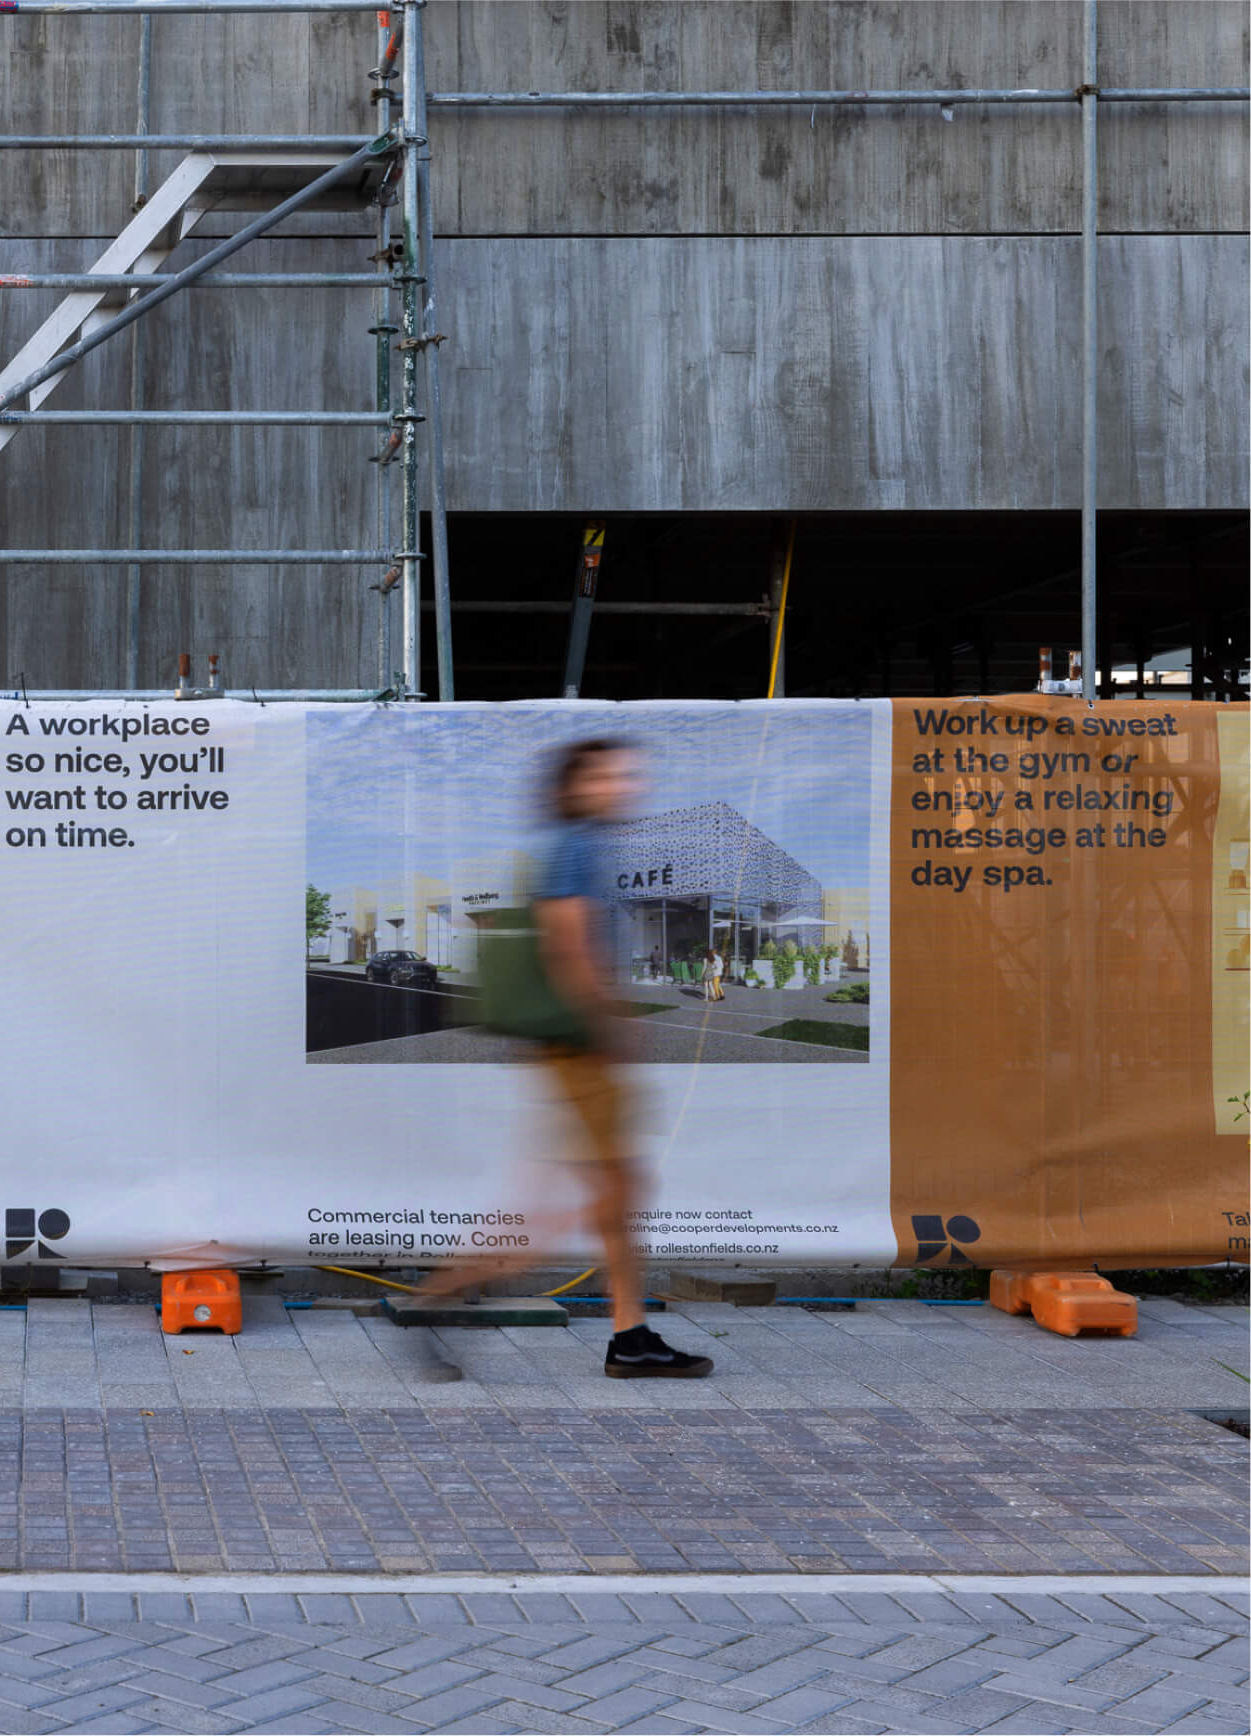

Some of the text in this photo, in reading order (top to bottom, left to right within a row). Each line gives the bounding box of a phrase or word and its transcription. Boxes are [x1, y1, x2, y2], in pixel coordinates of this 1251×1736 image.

[6, 714, 210, 742] A workplace
[914, 709, 1178, 741] Work up a sweat
[6, 752, 45, 773] so
[55, 746, 130, 778] nice,
[913, 747, 1138, 779] at the gym or
[6, 783, 229, 810] want to arrive
[912, 784, 1174, 817] enjoy a relaxing
[6, 821, 135, 847] on time.
[912, 822, 1166, 854] massage at the
[617, 863, 673, 889] CAFÉ
[911, 860, 1052, 892] day spa.
[307, 1208, 525, 1225] Commercial tenancies
[675, 1210, 701, 1220] now
[705, 1209, 752, 1220] contact
[308, 1229, 530, 1249] are leasing now. Come
[656, 1242, 779, 1254] rollestonfields.co.nz
